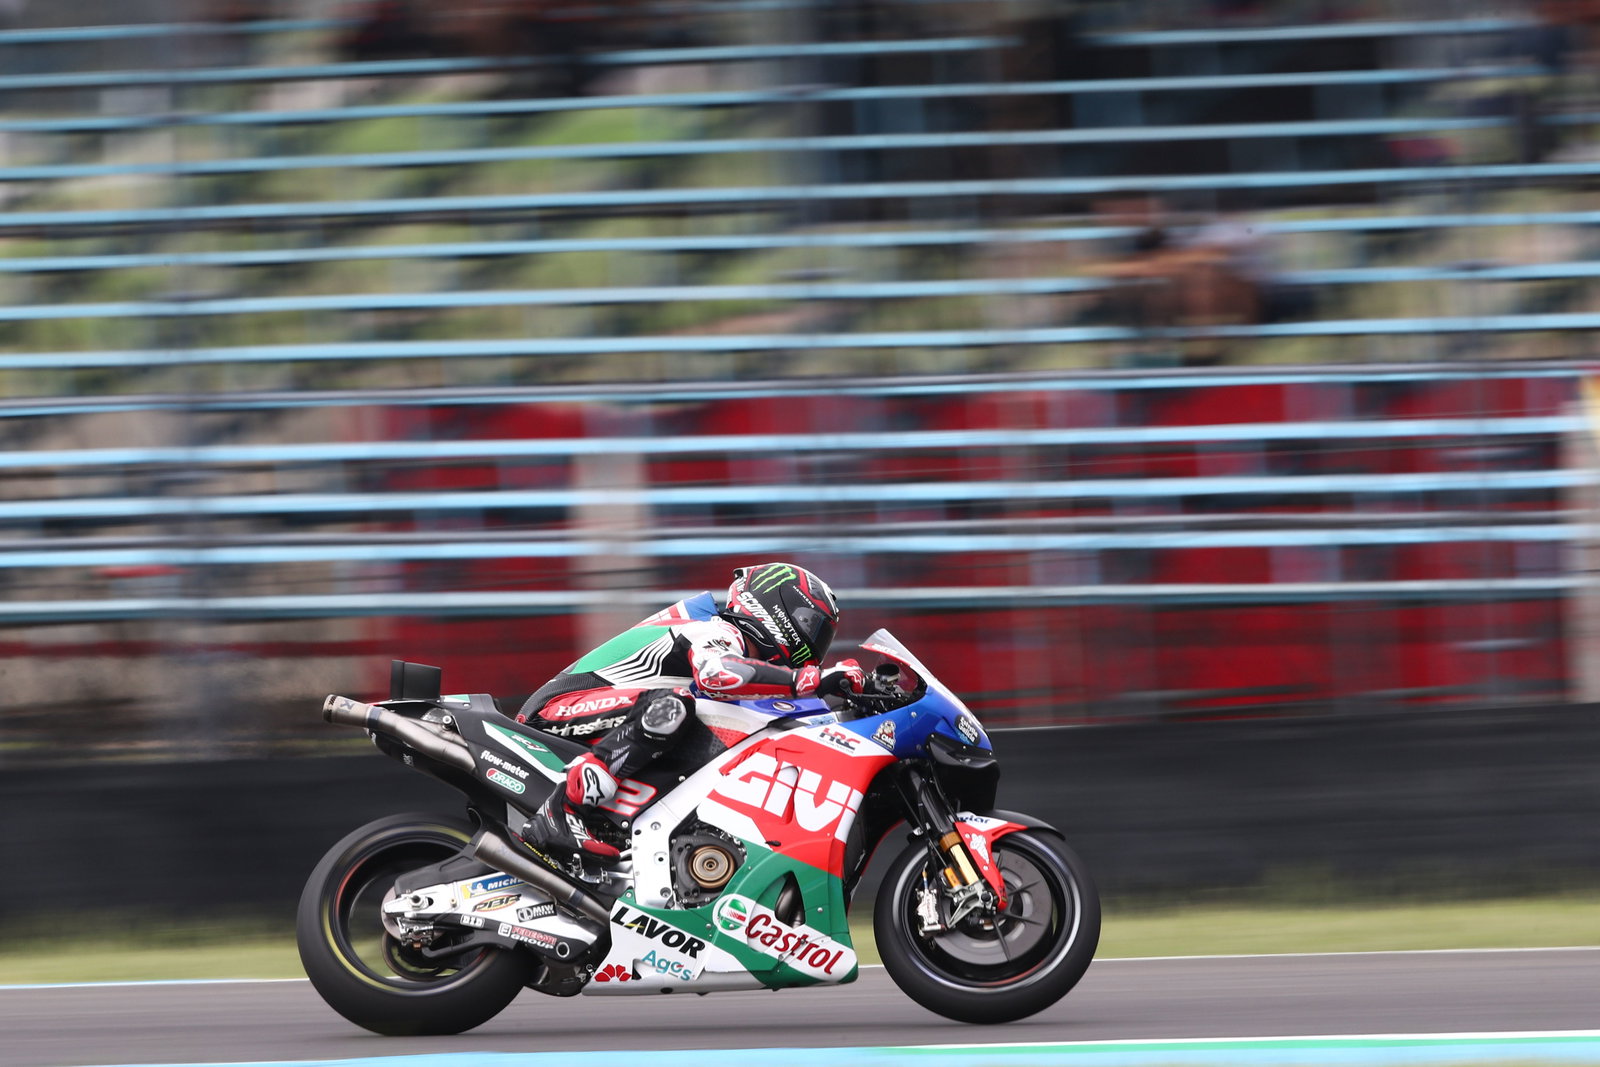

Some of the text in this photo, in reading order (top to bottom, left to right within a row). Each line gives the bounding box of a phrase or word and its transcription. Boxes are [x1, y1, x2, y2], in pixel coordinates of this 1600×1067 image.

[737, 591, 787, 644] SCORPION
[772, 604, 802, 646] MONSTER
[555, 696, 633, 717] HONDA
[819, 727, 861, 751] HRC
[480, 750, 530, 779] flow-meter
[492, 772, 522, 791] DRACO
[714, 752, 863, 842] GIVI
[472, 893, 522, 912] PBR
[533, 904, 554, 914] MIW
[462, 915, 484, 927] DID
[610, 905, 706, 959] LAVOR
[510, 933, 554, 949] GROUP
[744, 913, 845, 976] Castrol
[641, 949, 693, 982] Agos
